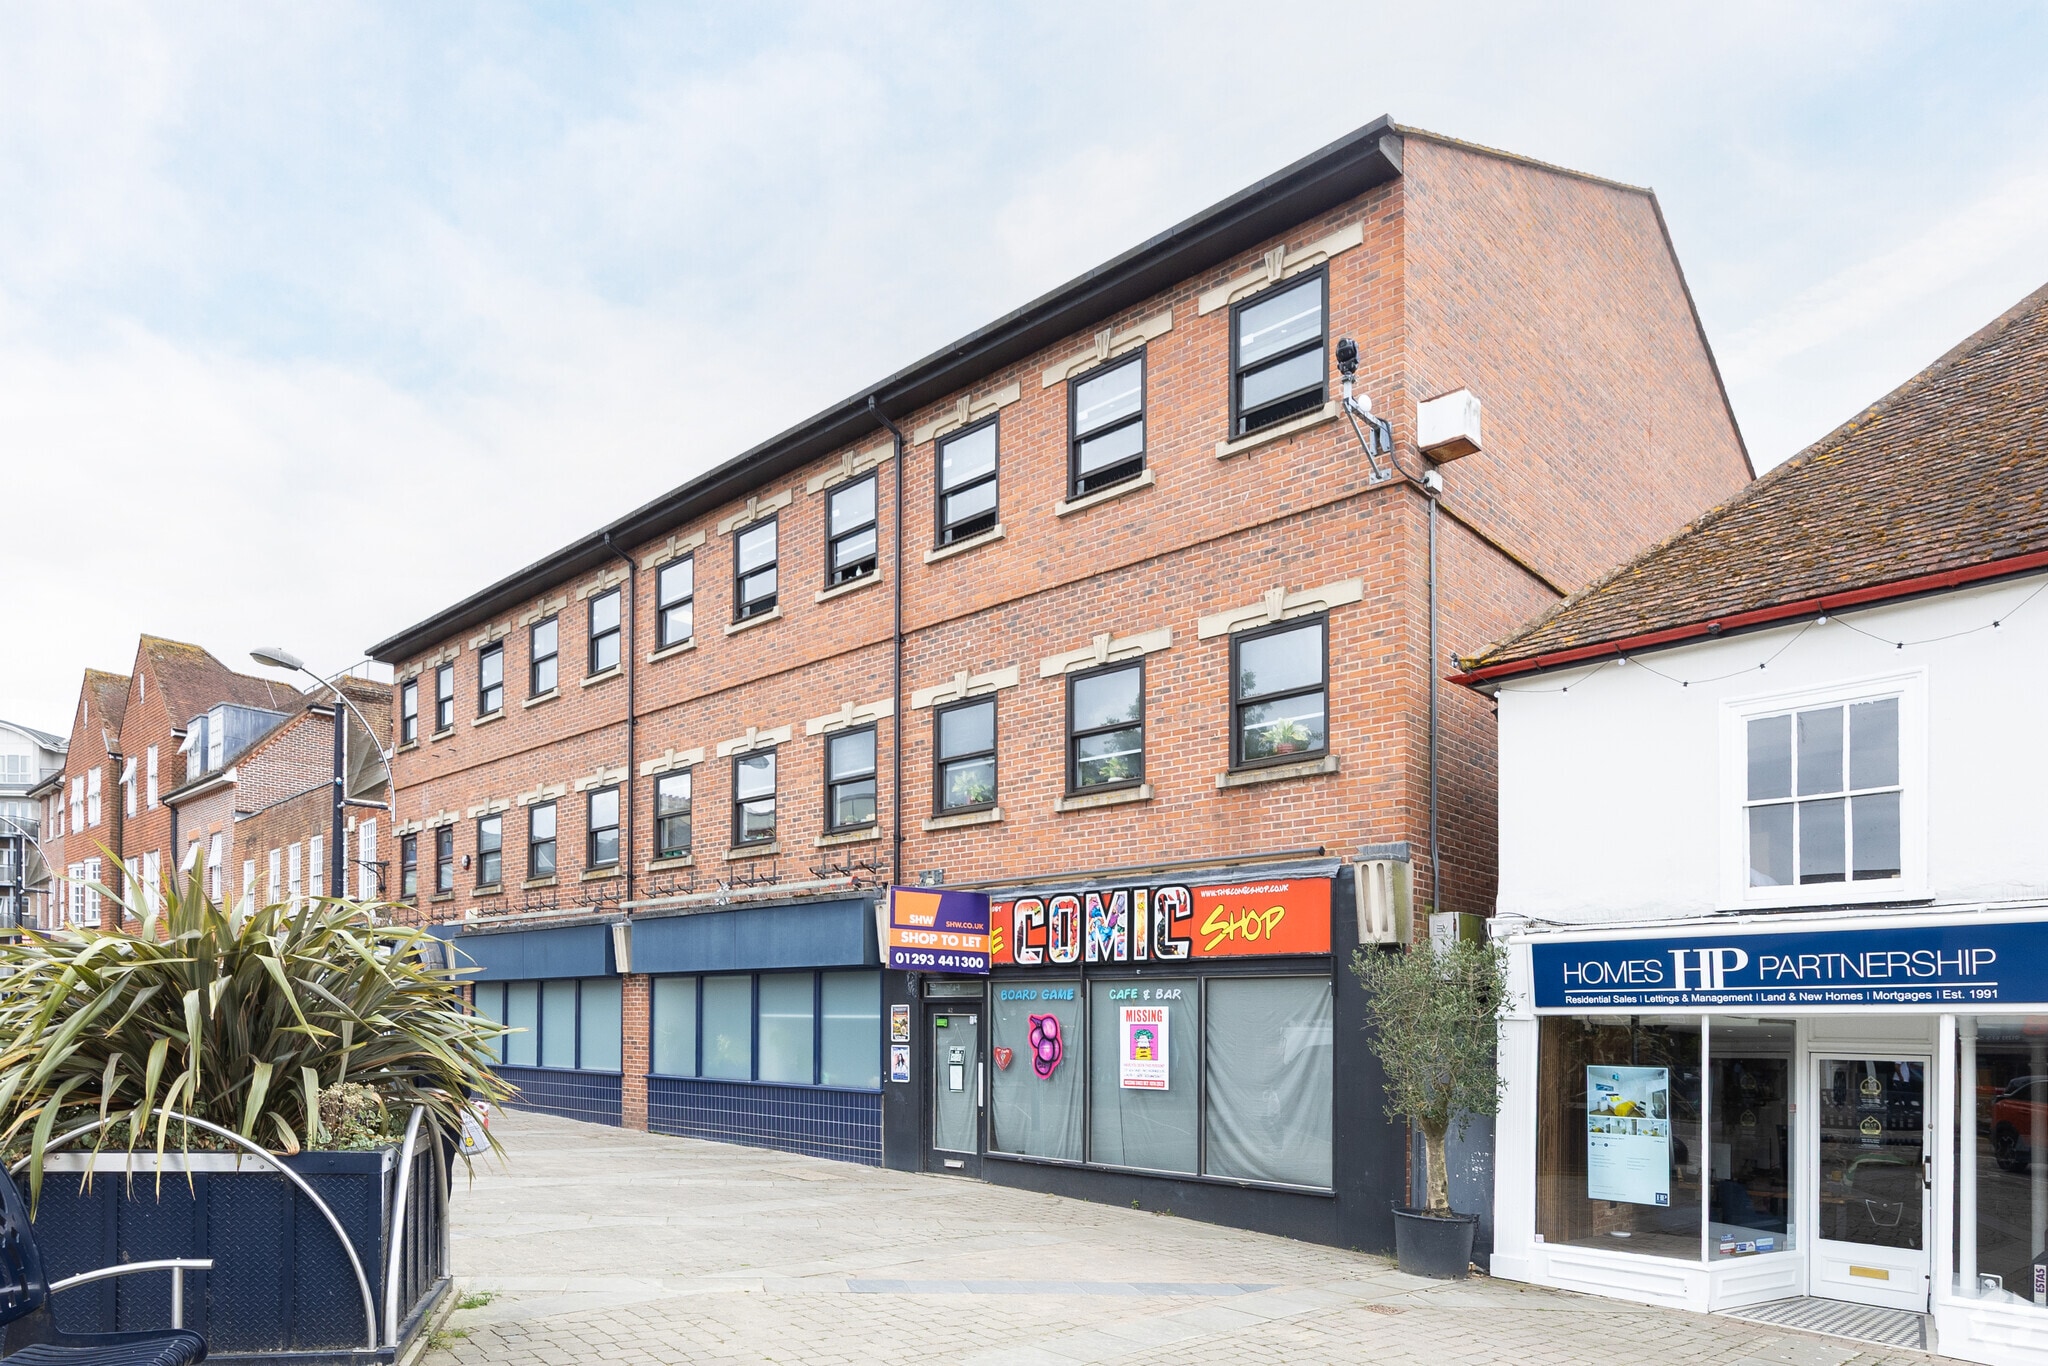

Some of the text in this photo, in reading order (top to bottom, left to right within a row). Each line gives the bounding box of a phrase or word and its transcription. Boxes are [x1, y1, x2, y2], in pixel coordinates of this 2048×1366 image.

[909, 914, 934, 925] SHW
[945, 920, 984, 930] SHW.CO.UK
[1012, 884, 1192, 966] COMIC
[1200, 903, 1286, 953] SHOP
[901, 931, 982, 948] SHOP TO LET
[895, 952, 984, 968] 01293 441300
[1563, 947, 1997, 991] HOMES HP PARTNERSHIP
[1001, 988, 1075, 1001] BOARD GAME
[1109, 988, 1182, 1001] CAFE & BAR
[1565, 989, 1999, 1005] Residential Sales Lettings & Management Land & New Homes Mortgages Est. 1991
[1125, 1009, 1163, 1022] MISSING
[2035, 1268, 2045, 1293] ESTAS
